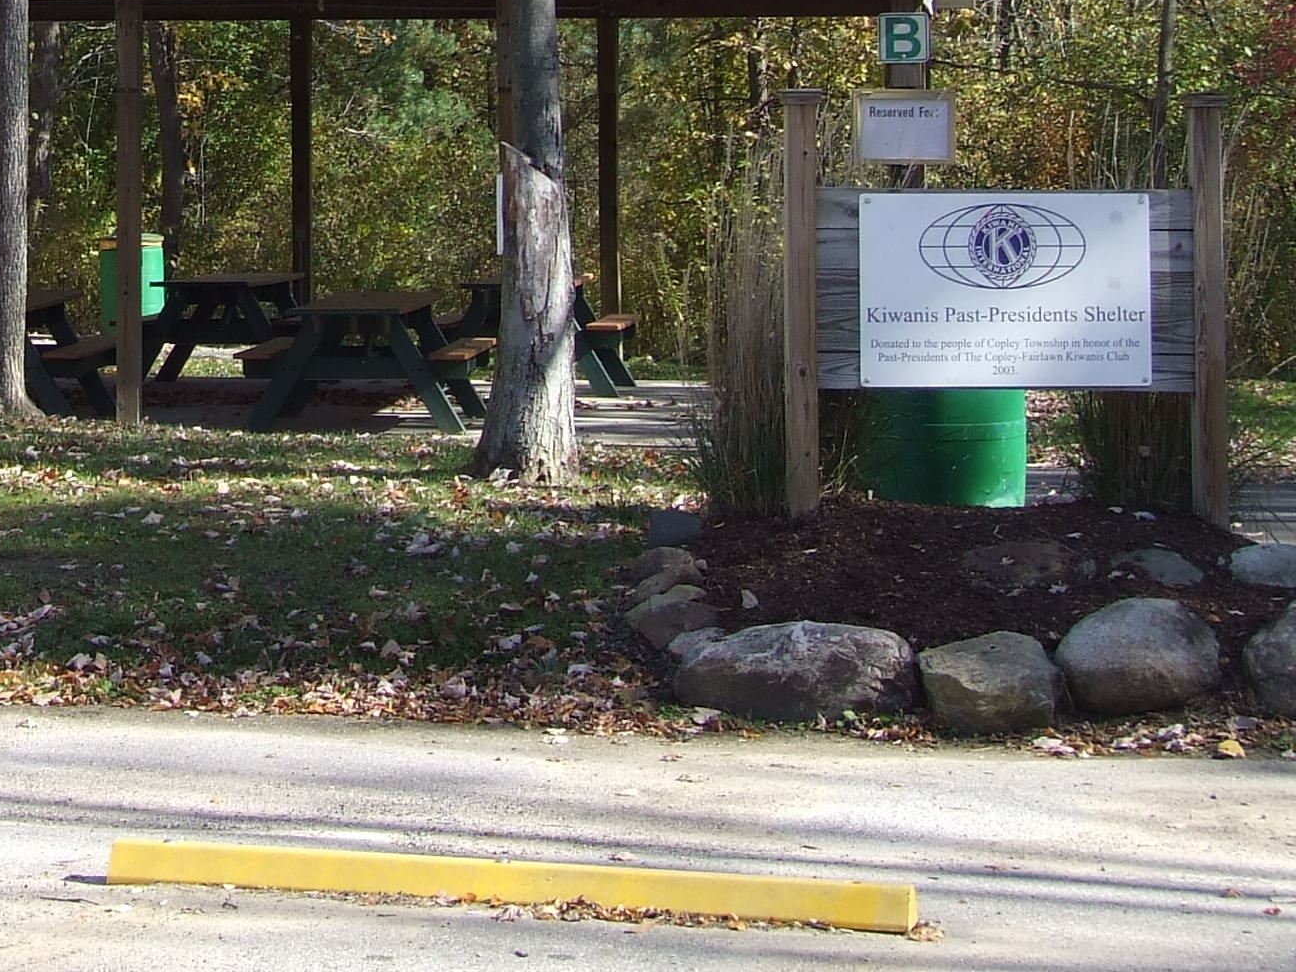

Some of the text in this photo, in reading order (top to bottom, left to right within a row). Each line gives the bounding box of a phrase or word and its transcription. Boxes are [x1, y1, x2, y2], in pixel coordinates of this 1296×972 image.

[885, 17, 921, 59] B
[869, 107, 914, 118] Reserved
[982, 218, 1023, 234] KIWANIS
[975, 245, 1030, 275] INTERNATIONAL
[867, 306, 1146, 323] Kiwanis Past-Presidents Shelter
[870, 338, 1140, 350] Donated to the people of Copley Township in honor of the
[878, 351, 1130, 363] Past-Presidents of The Copley-Fairlawn Kiwanis Club
